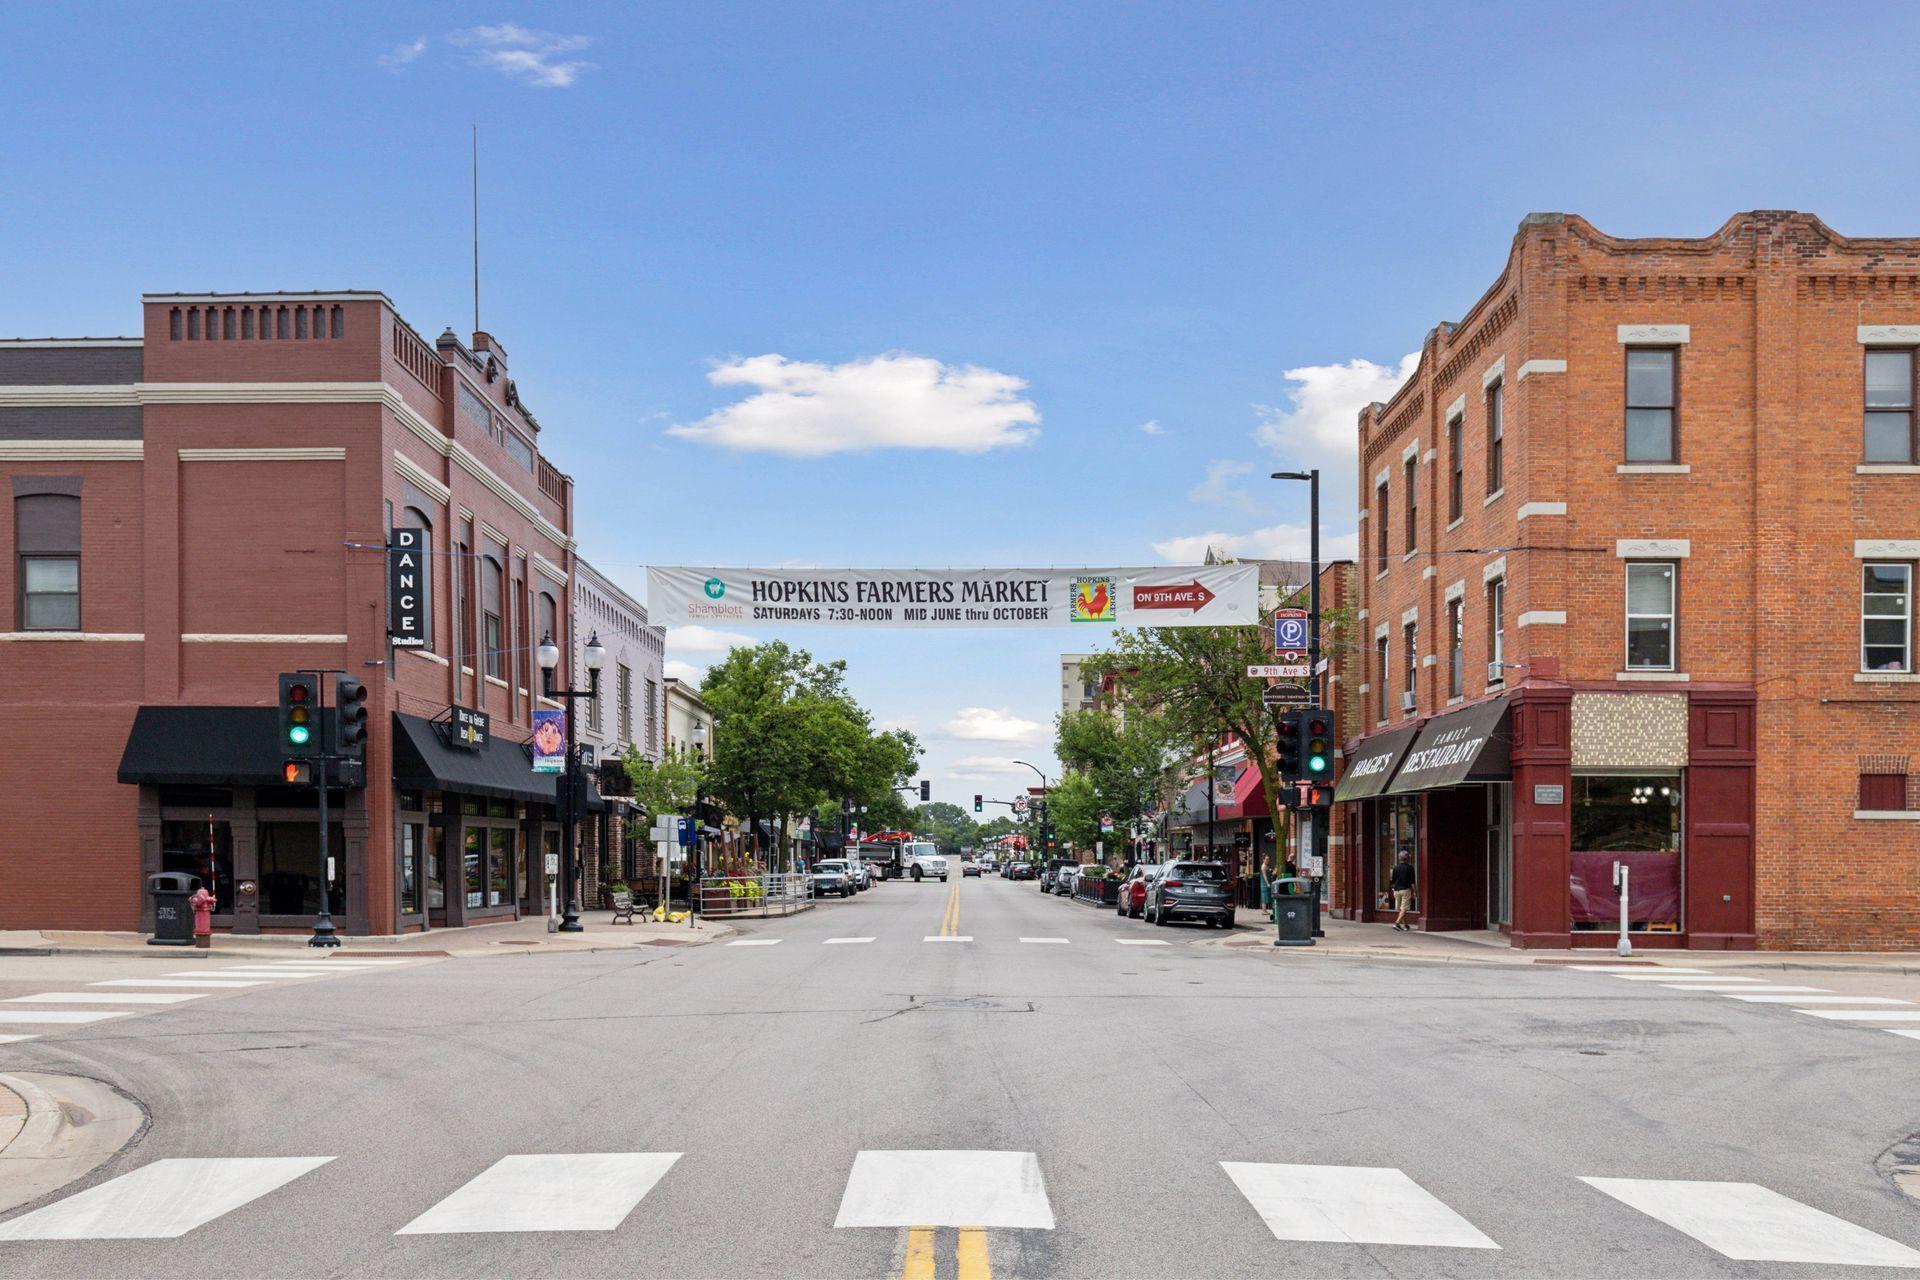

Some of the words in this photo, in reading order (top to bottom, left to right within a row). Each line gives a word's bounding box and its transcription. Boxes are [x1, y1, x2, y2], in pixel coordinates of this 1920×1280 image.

[399, 532, 415, 631] DANCE
[751, 580, 850, 603] HOPKINS
[856, 581, 954, 603] FARMERS
[961, 580, 1048, 603] MARKET
[1136, 593, 1152, 602] ON
[1154, 592, 1171, 602] 9TH
[1174, 592, 1196, 601] AVE.
[1197, 592, 1205, 600] S
[687, 603, 743, 614] Shamblott
[753, 607, 821, 620] SATURDAYS
[827, 608, 893, 621] 7:30-NOON
[904, 608, 927, 621] MID
[931, 608, 962, 621] JUNE
[965, 608, 990, 620] thru
[993, 607, 1049, 620] OCTOBER
[1287, 623, 1298, 639] P
[392, 637, 424, 646] Studios
[1263, 666, 1278, 676] 9th
[1282, 666, 1298, 675] Ave
[1302, 666, 1308, 675] S
[1433, 726, 1472, 746] FAMILY
[1401, 738, 1483, 774] RESTAURANT
